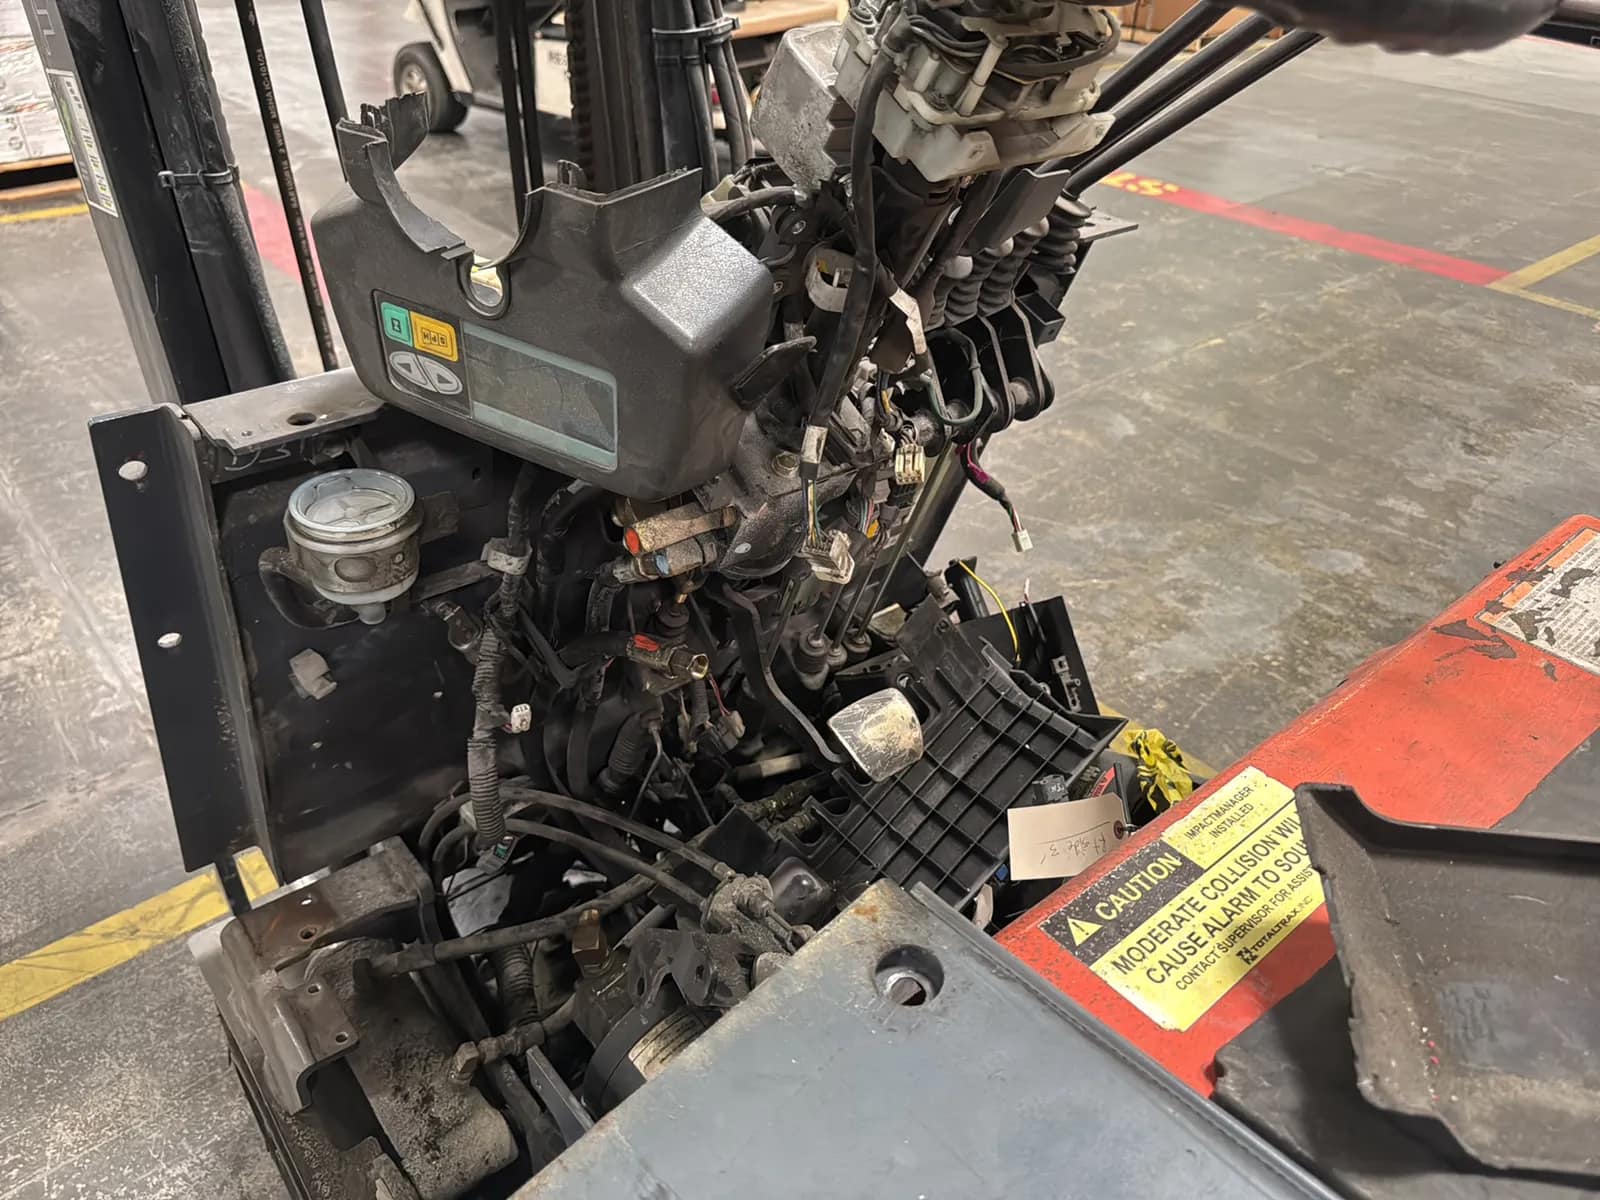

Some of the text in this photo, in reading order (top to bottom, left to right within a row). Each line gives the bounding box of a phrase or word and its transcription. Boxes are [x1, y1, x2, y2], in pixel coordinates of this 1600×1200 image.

[1184, 785, 1254, 840] IMPACTMANAGER
[1208, 803, 1254, 839] INSTALLED
[1095, 851, 1182, 920] CAUTION
[1111, 815, 1302, 975] MODERATE COLLISION WIL
[1146, 840, 1308, 984] CAUSE ALARM TO SOU
[1175, 949, 1221, 990] CONTACT
[1216, 904, 1273, 954] SUPERVISOR
[1269, 888, 1291, 909] FOR
[1249, 908, 1299, 952] TOTALTRAX
